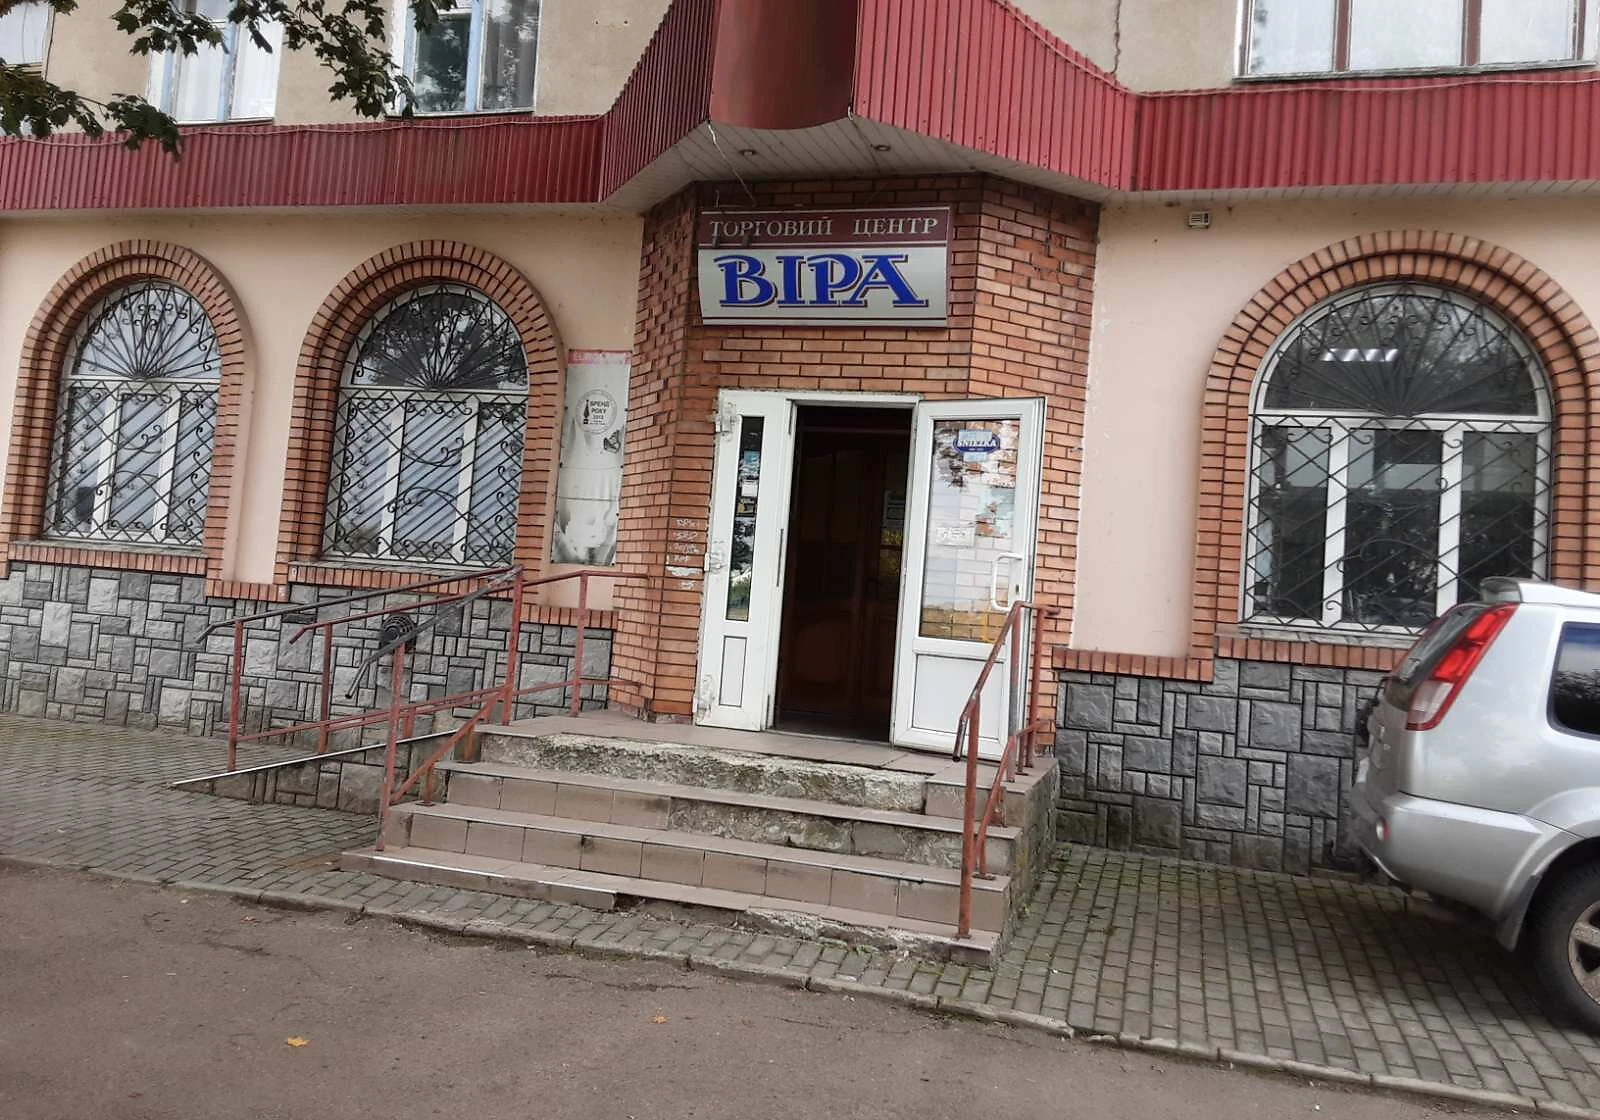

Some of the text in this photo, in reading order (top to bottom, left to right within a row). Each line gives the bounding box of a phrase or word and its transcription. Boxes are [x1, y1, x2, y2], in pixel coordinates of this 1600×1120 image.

[710, 216, 939, 238] ТОРГОВИЙ ЦЕНТР
[713, 253, 929, 308] ВІРА
